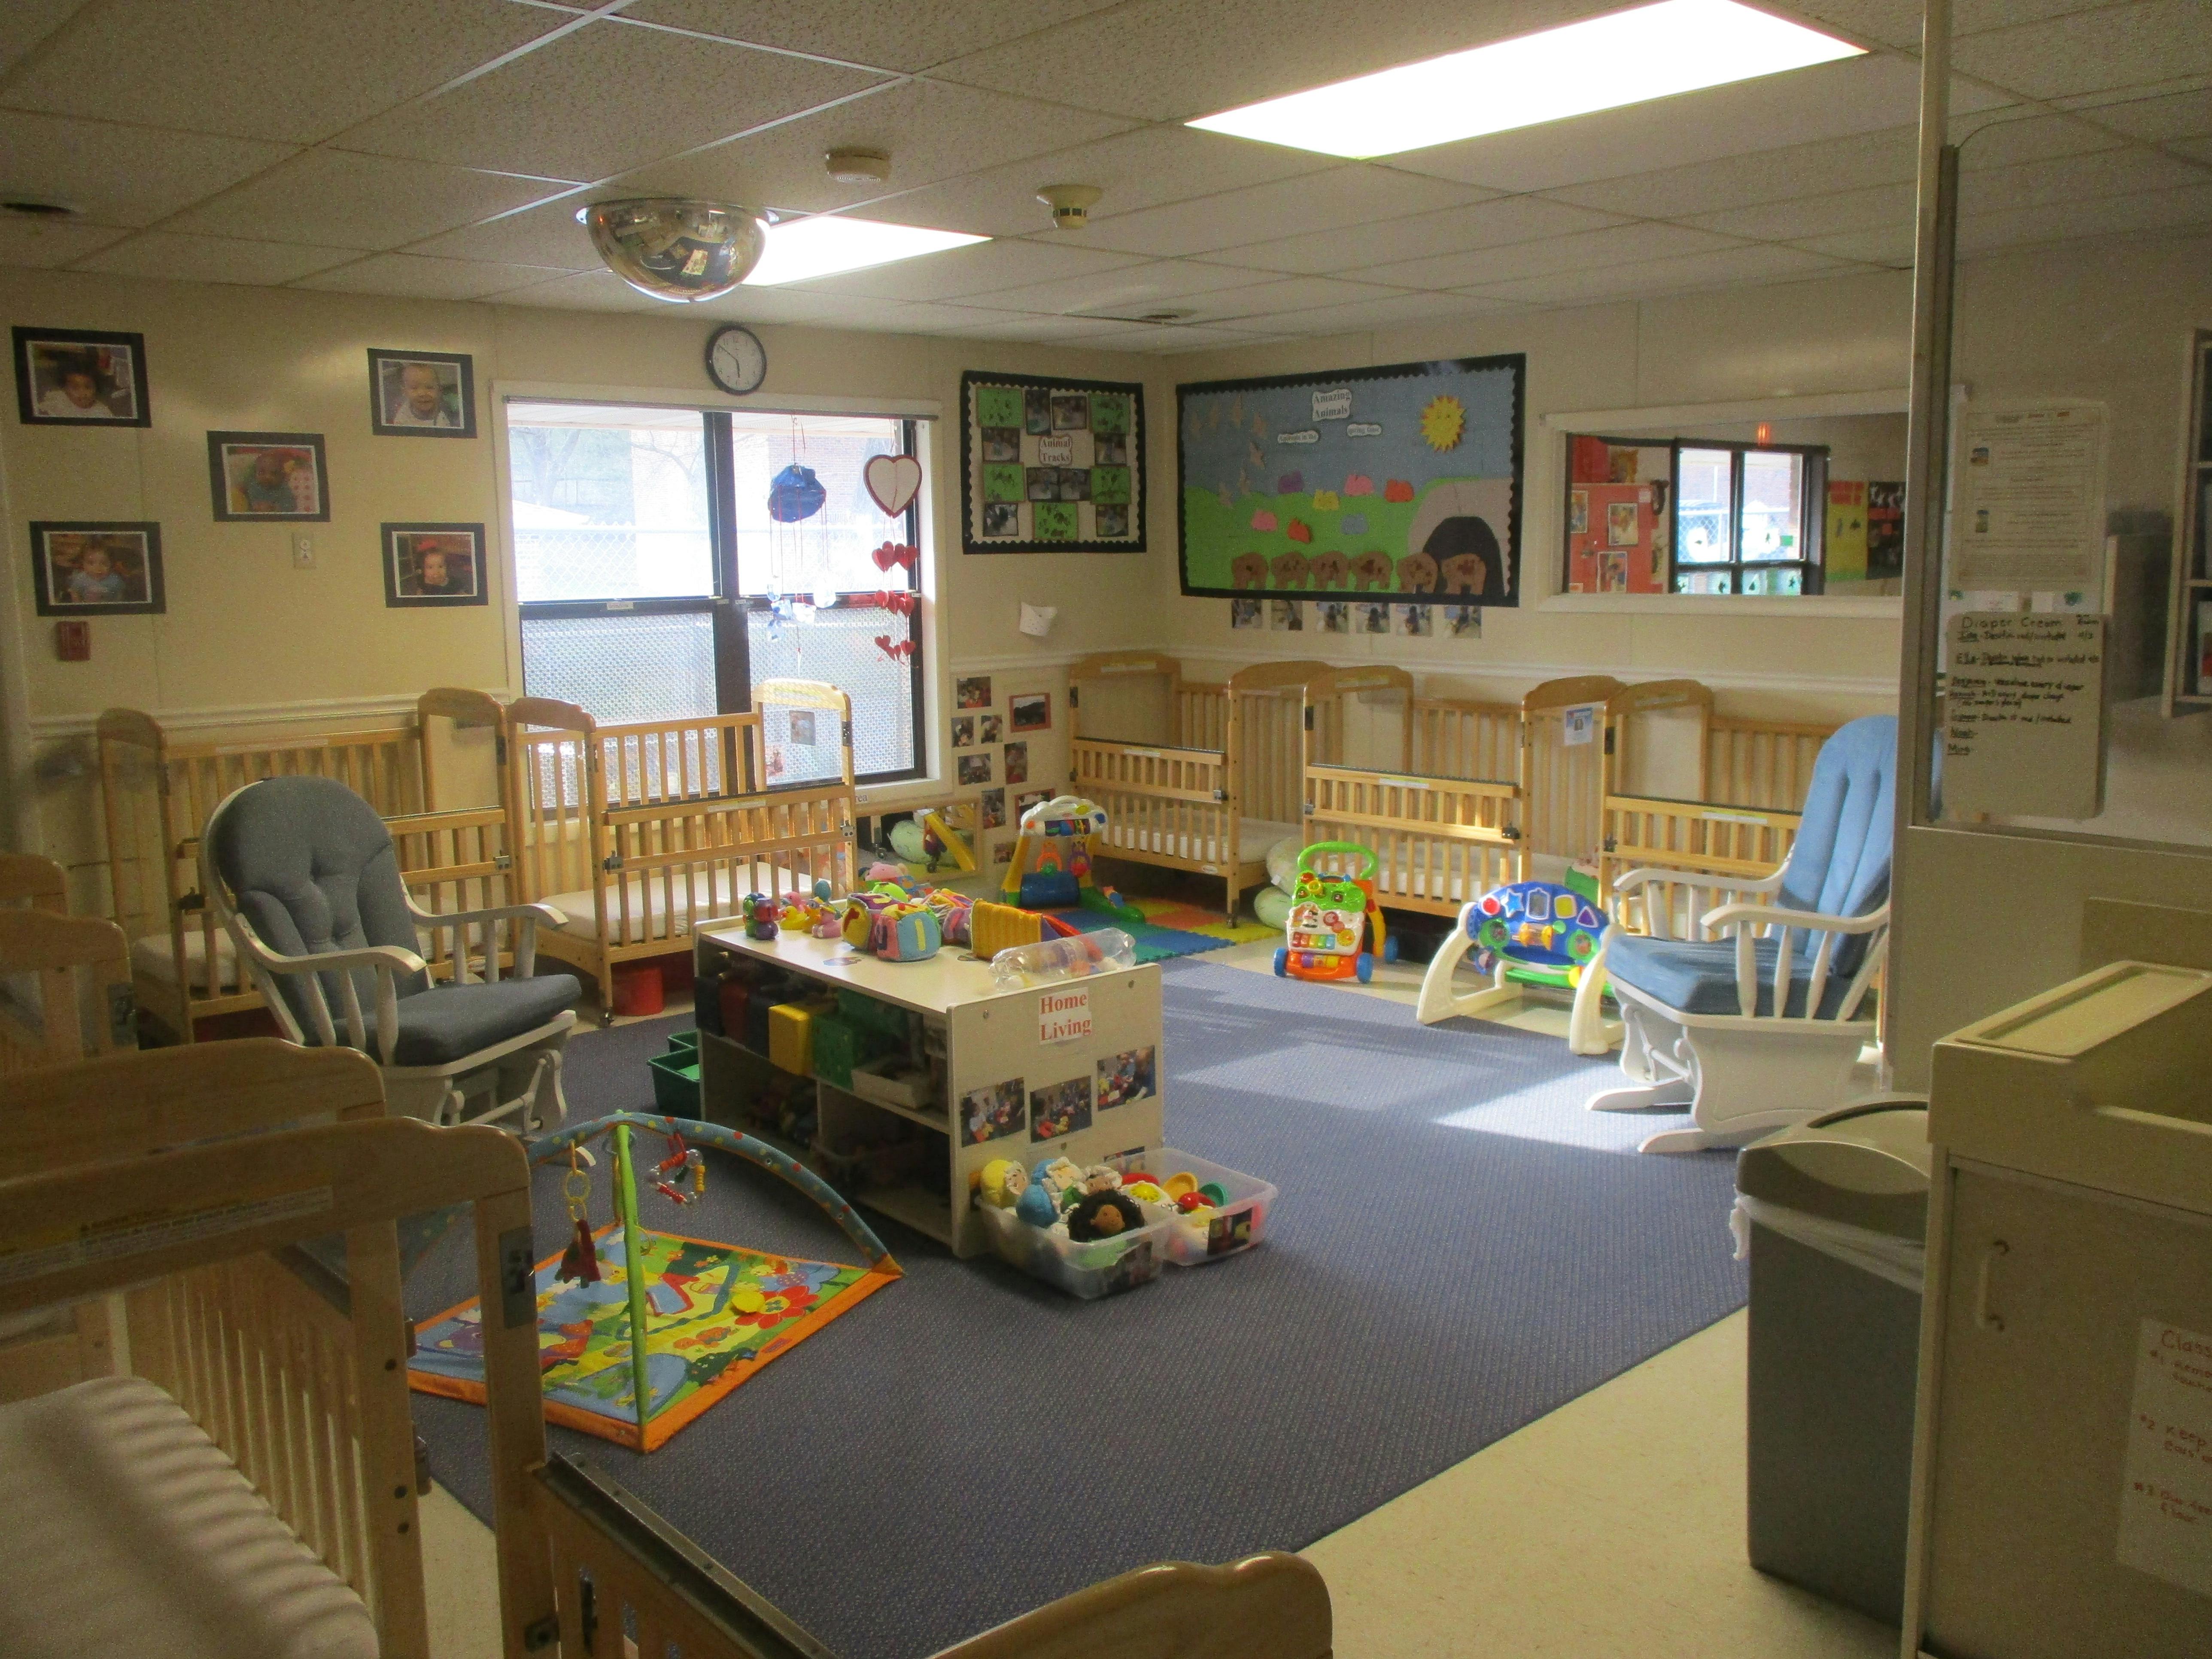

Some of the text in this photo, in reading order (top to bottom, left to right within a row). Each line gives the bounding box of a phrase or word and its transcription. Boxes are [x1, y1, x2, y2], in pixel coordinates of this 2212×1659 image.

[1314, 391, 1351, 404] Amazing
[1315, 405, 1348, 418] Animals
[1041, 438, 1070, 447] Animal
[1041, 453, 1070, 462] Tracks
[1962, 617, 2062, 629] Diaper Cream
[854, 794, 868, 802] rea
[1041, 994, 1088, 1014] Home
[1041, 1019, 1091, 1041] Living
